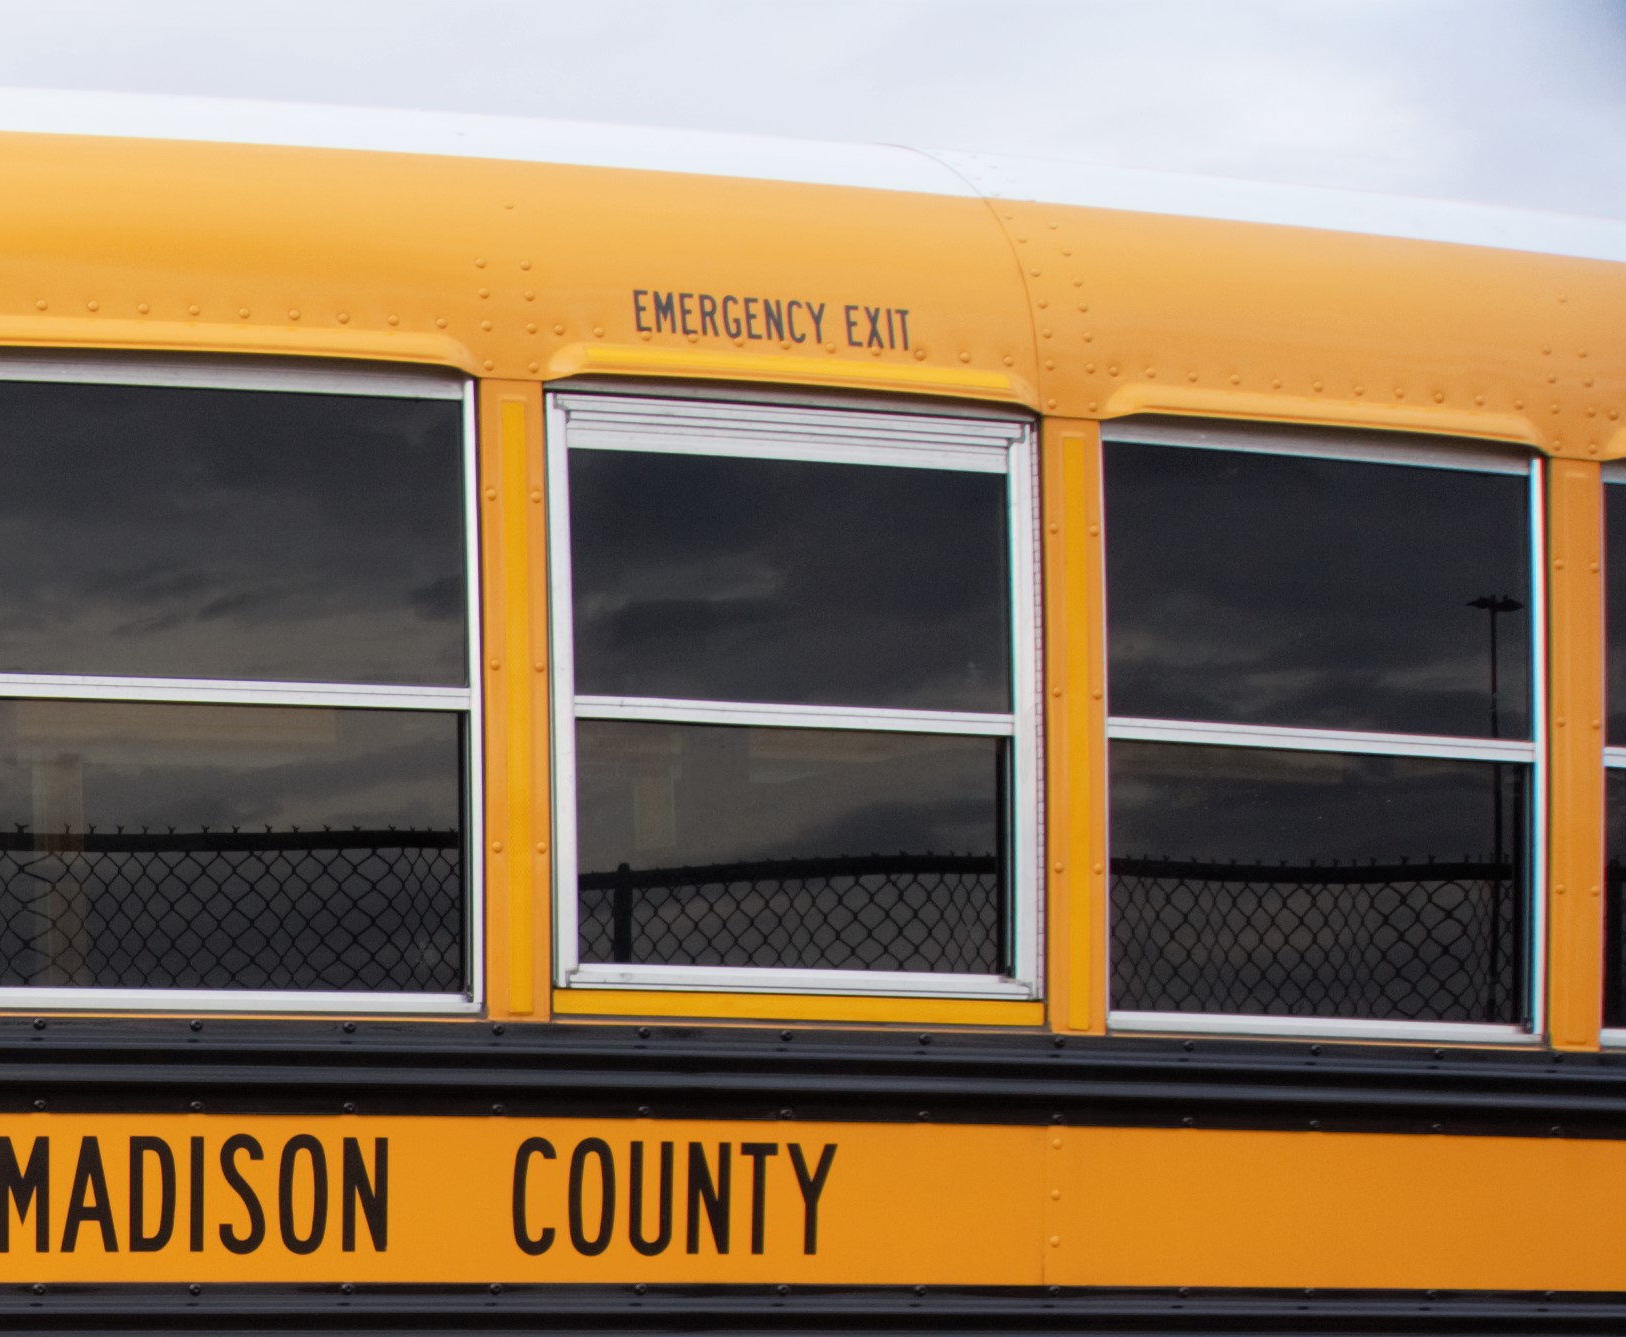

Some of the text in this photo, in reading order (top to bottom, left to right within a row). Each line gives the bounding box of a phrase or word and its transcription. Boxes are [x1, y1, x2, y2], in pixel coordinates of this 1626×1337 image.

[633, 289, 910, 351] EMERGENCY EXIT
[511, 1136, 839, 1257] COUNTY
